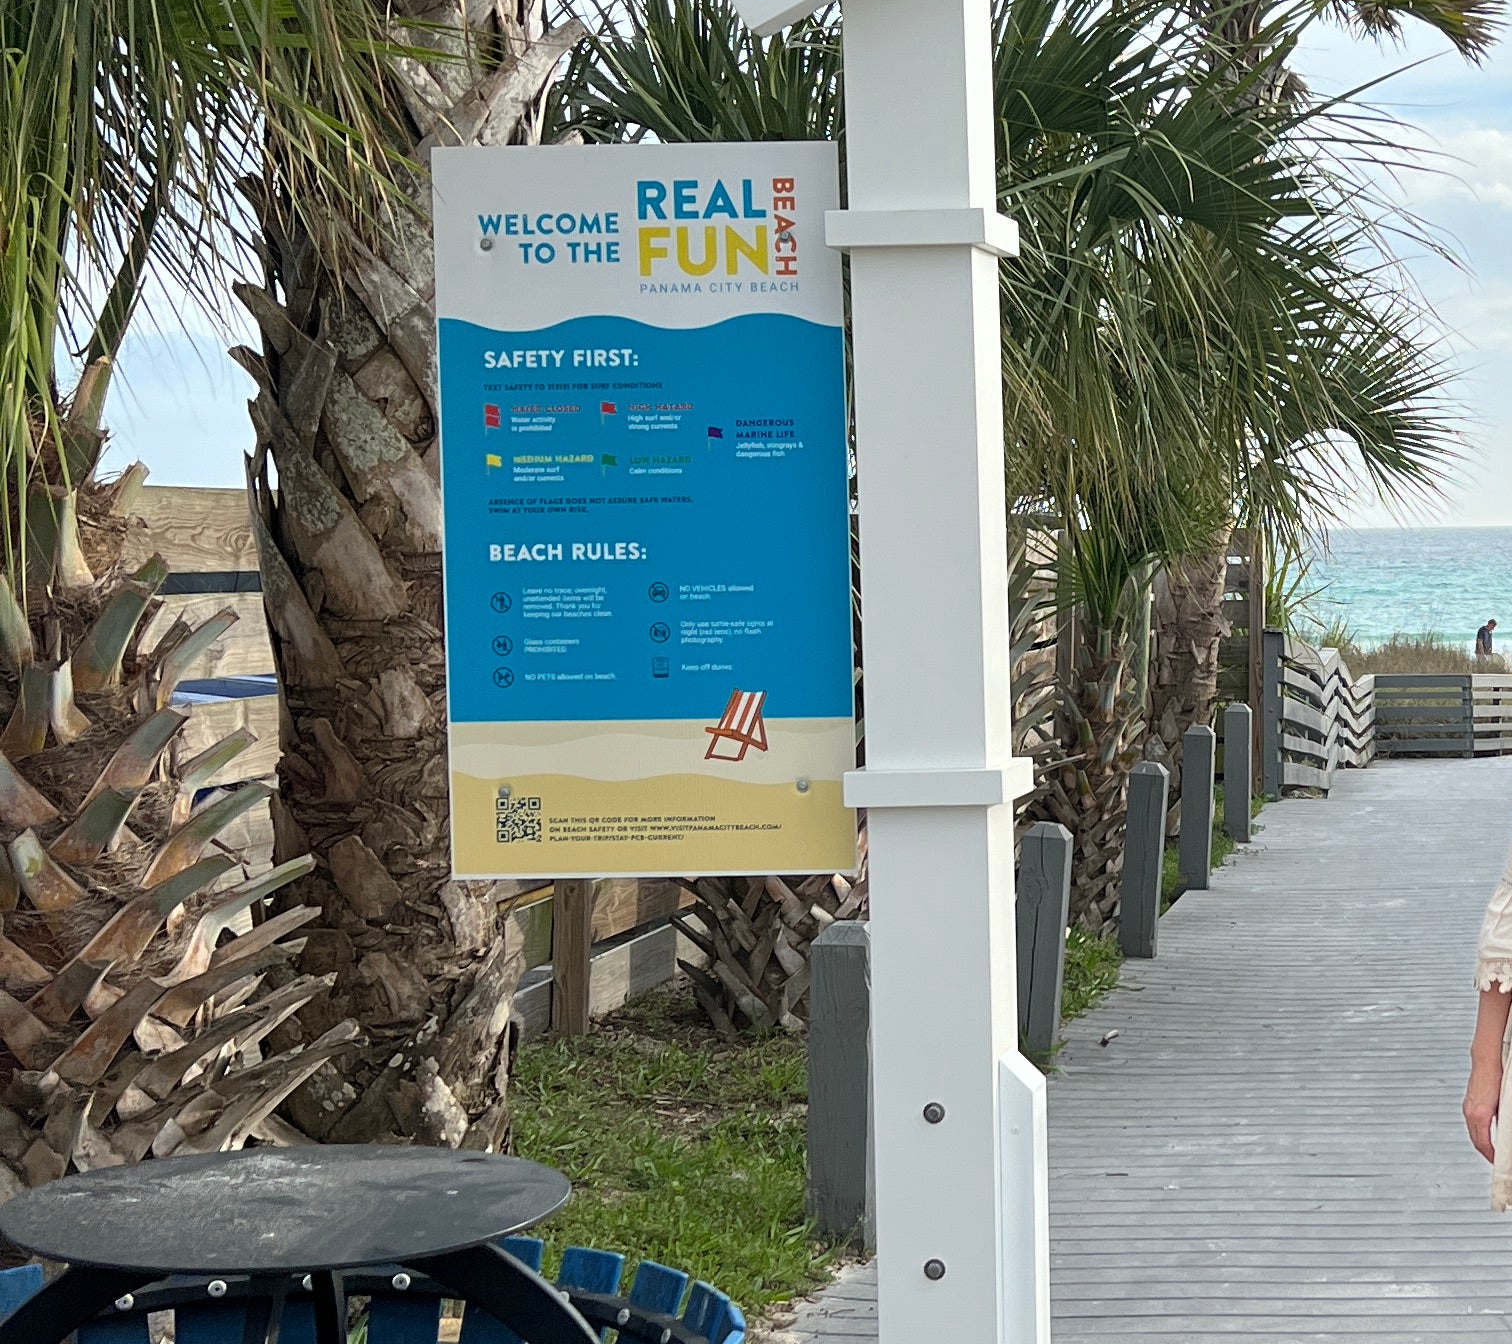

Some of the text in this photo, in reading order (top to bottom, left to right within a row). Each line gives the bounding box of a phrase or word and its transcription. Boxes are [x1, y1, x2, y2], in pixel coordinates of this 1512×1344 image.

[637, 179, 767, 220] REAL
[477, 212, 619, 235] WELCOME
[772, 178, 798, 276] BEACH
[518, 241, 620, 264] TO THE
[638, 225, 770, 277] FUN
[639, 281, 799, 294] PANAMA CITY BEACH
[484, 349, 638, 369] SAFETY FIRST:
[735, 419, 794, 427] DANGEROUS
[736, 430, 795, 439] MARINE LIFE
[489, 542, 647, 561] BEACH RULES:
